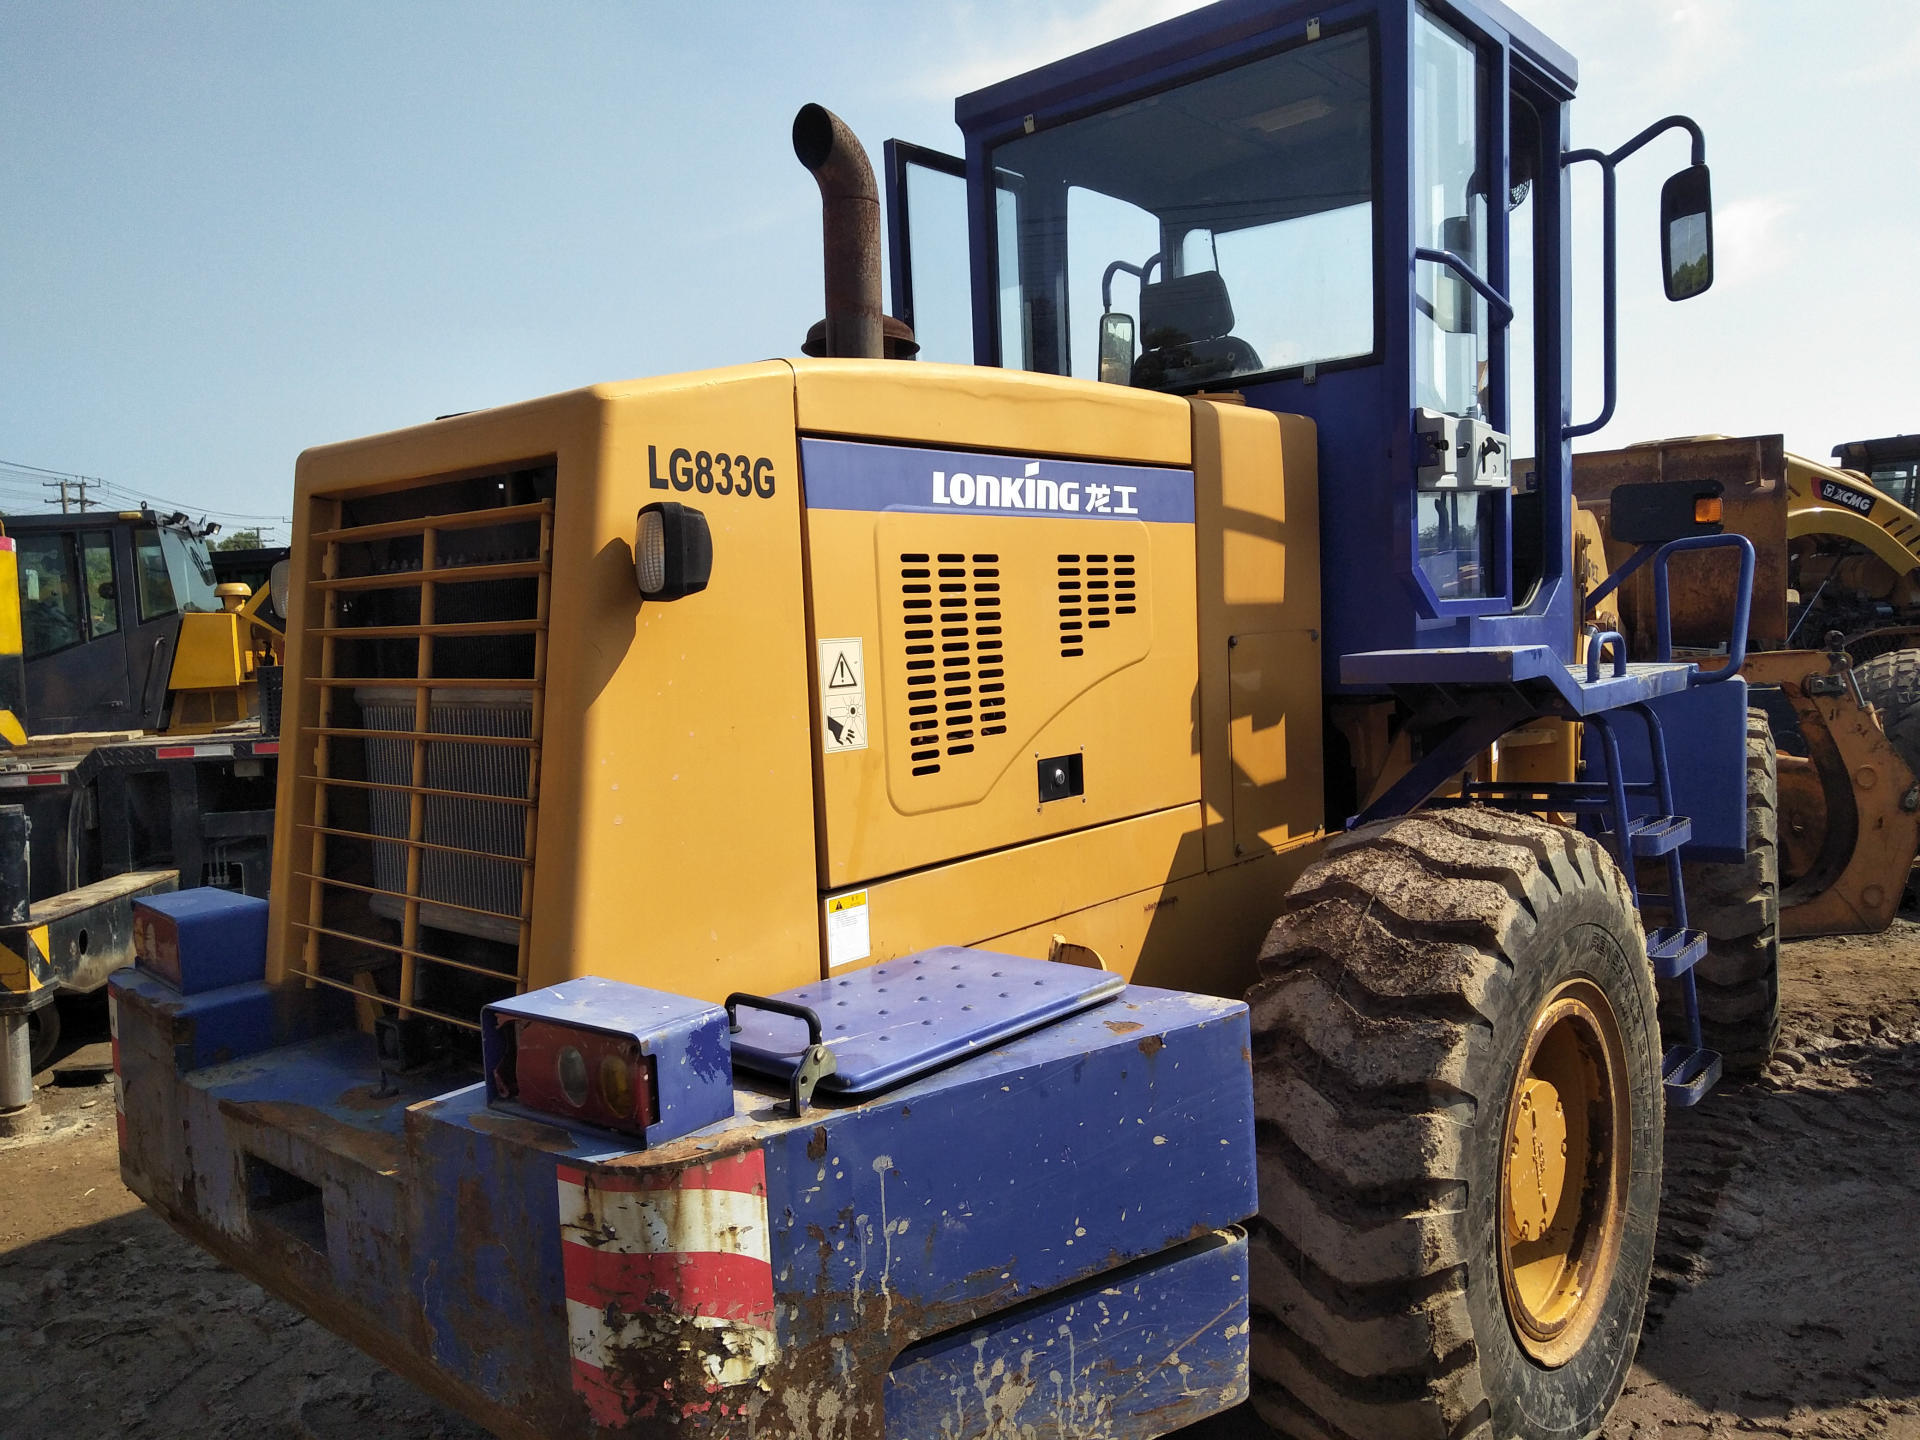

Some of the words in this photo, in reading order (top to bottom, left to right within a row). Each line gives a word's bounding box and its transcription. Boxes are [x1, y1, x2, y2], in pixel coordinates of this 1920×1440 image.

[648, 445, 776, 499] LG833G
[1084, 483, 1139, 514] 龙工
[1832, 488, 1870, 510] XCMG
